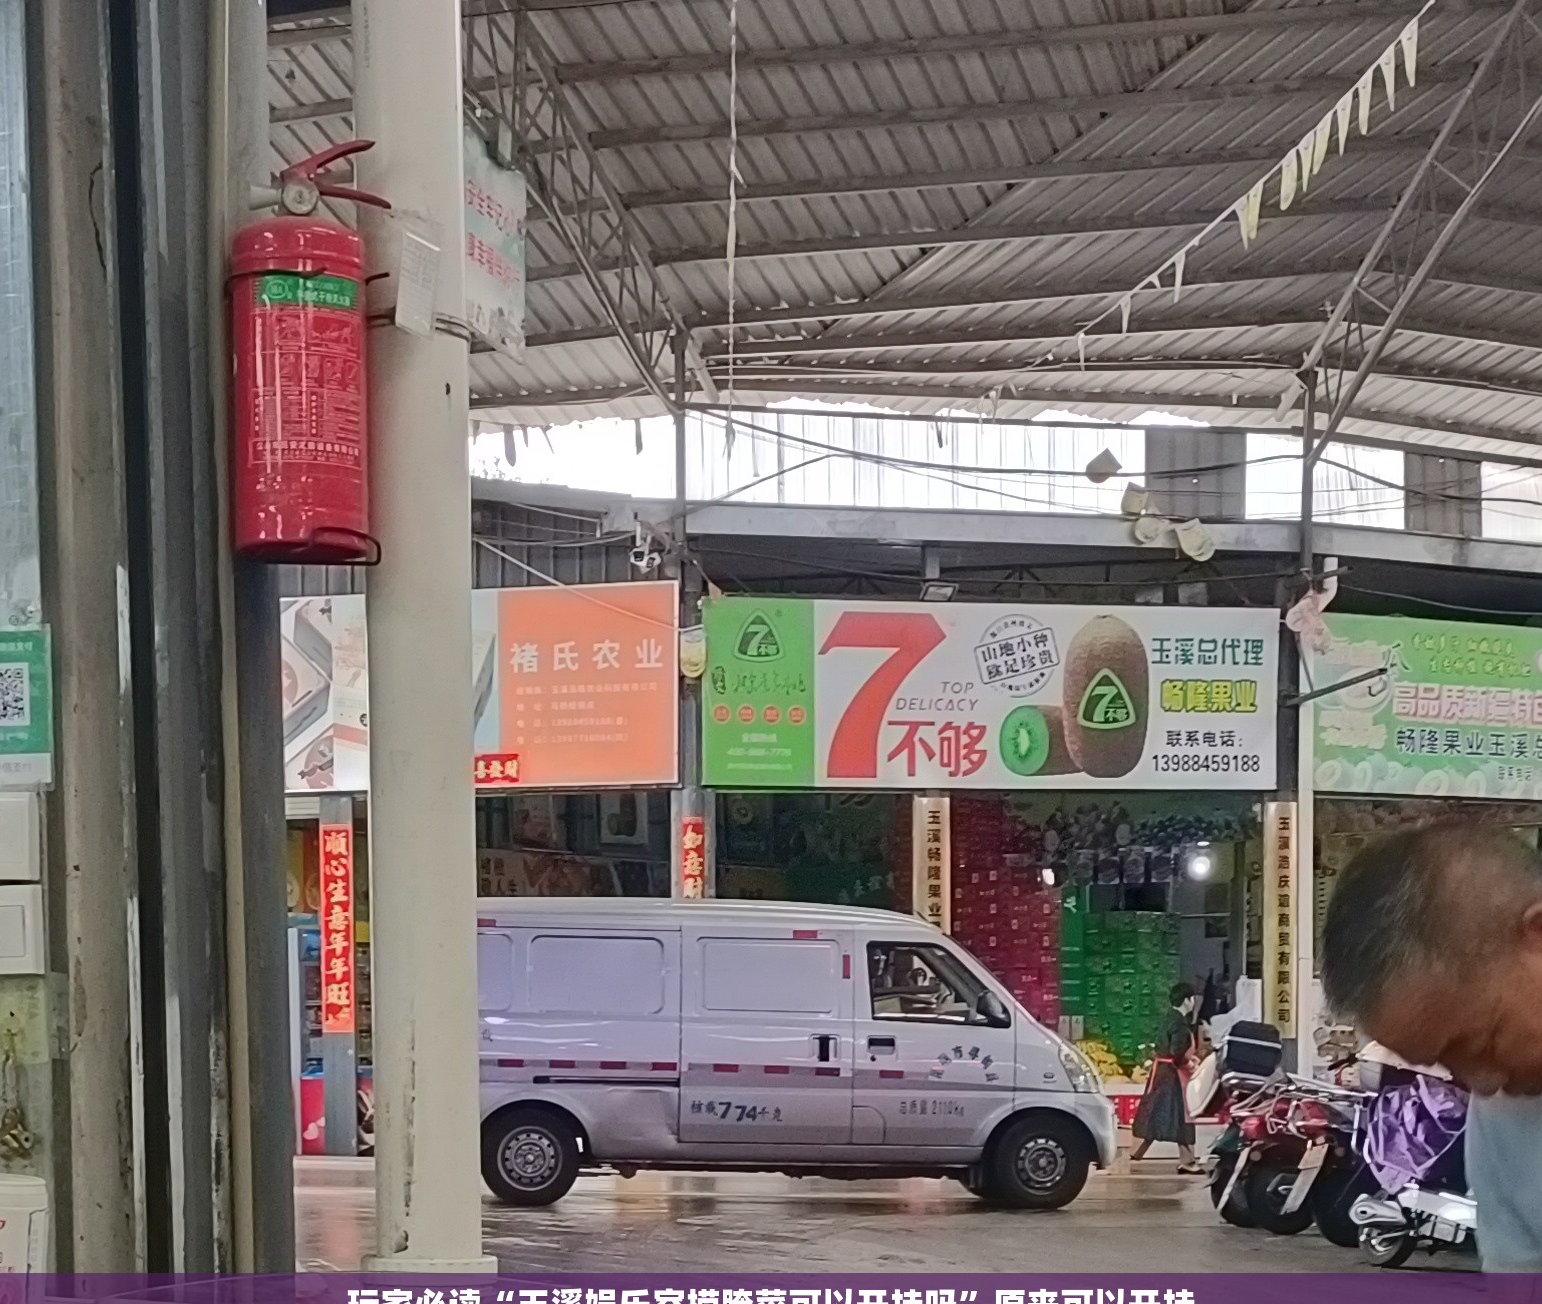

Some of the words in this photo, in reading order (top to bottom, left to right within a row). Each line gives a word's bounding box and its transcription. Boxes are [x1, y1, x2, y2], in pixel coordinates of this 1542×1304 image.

[509, 638, 664, 674] 褚氏农业
[1151, 637, 1264, 666] 玉溪总代理
[940, 681, 974, 695] TOP
[1161, 679, 1258, 713] 畅隆果业
[895, 698, 979, 712] DELICACY
[1151, 754, 1261, 773] 13988459188
